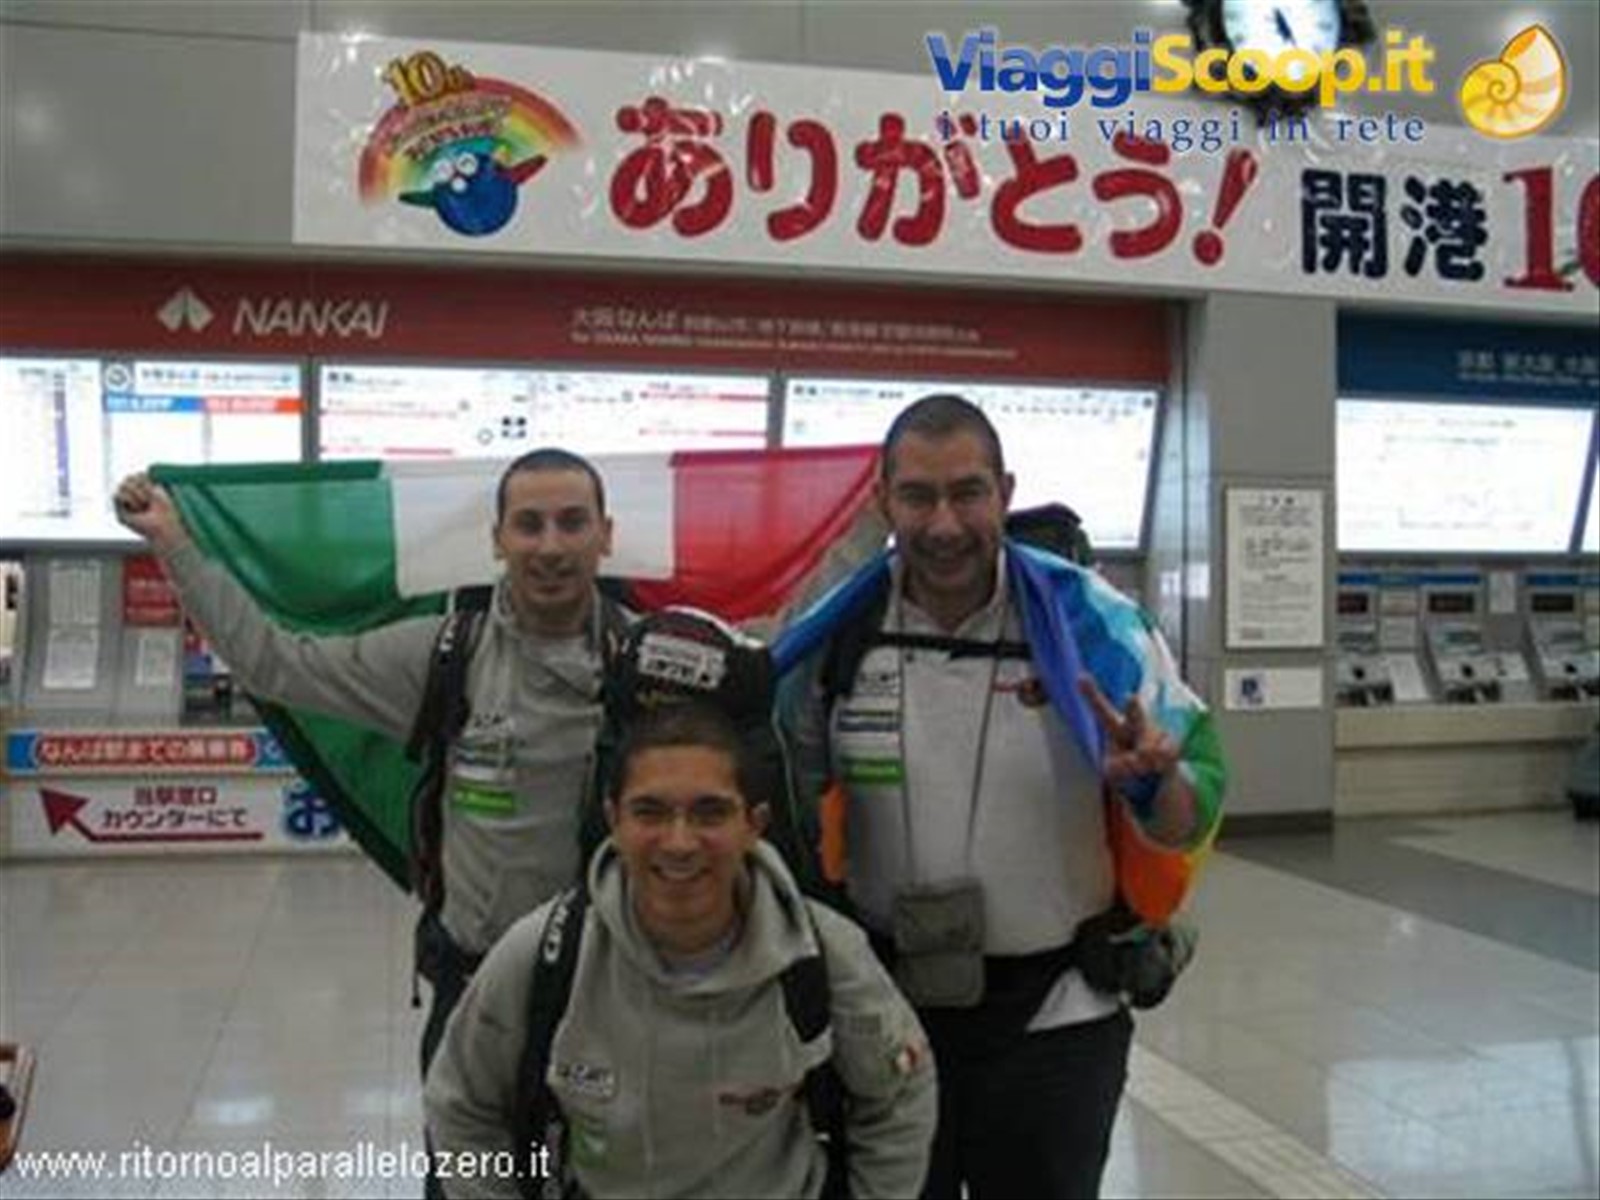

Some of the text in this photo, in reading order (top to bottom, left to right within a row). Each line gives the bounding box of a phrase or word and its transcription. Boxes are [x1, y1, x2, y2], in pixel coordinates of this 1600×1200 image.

[232, 299, 390, 337] NANKAI
[102, 807, 249, 830] カウンターにて
